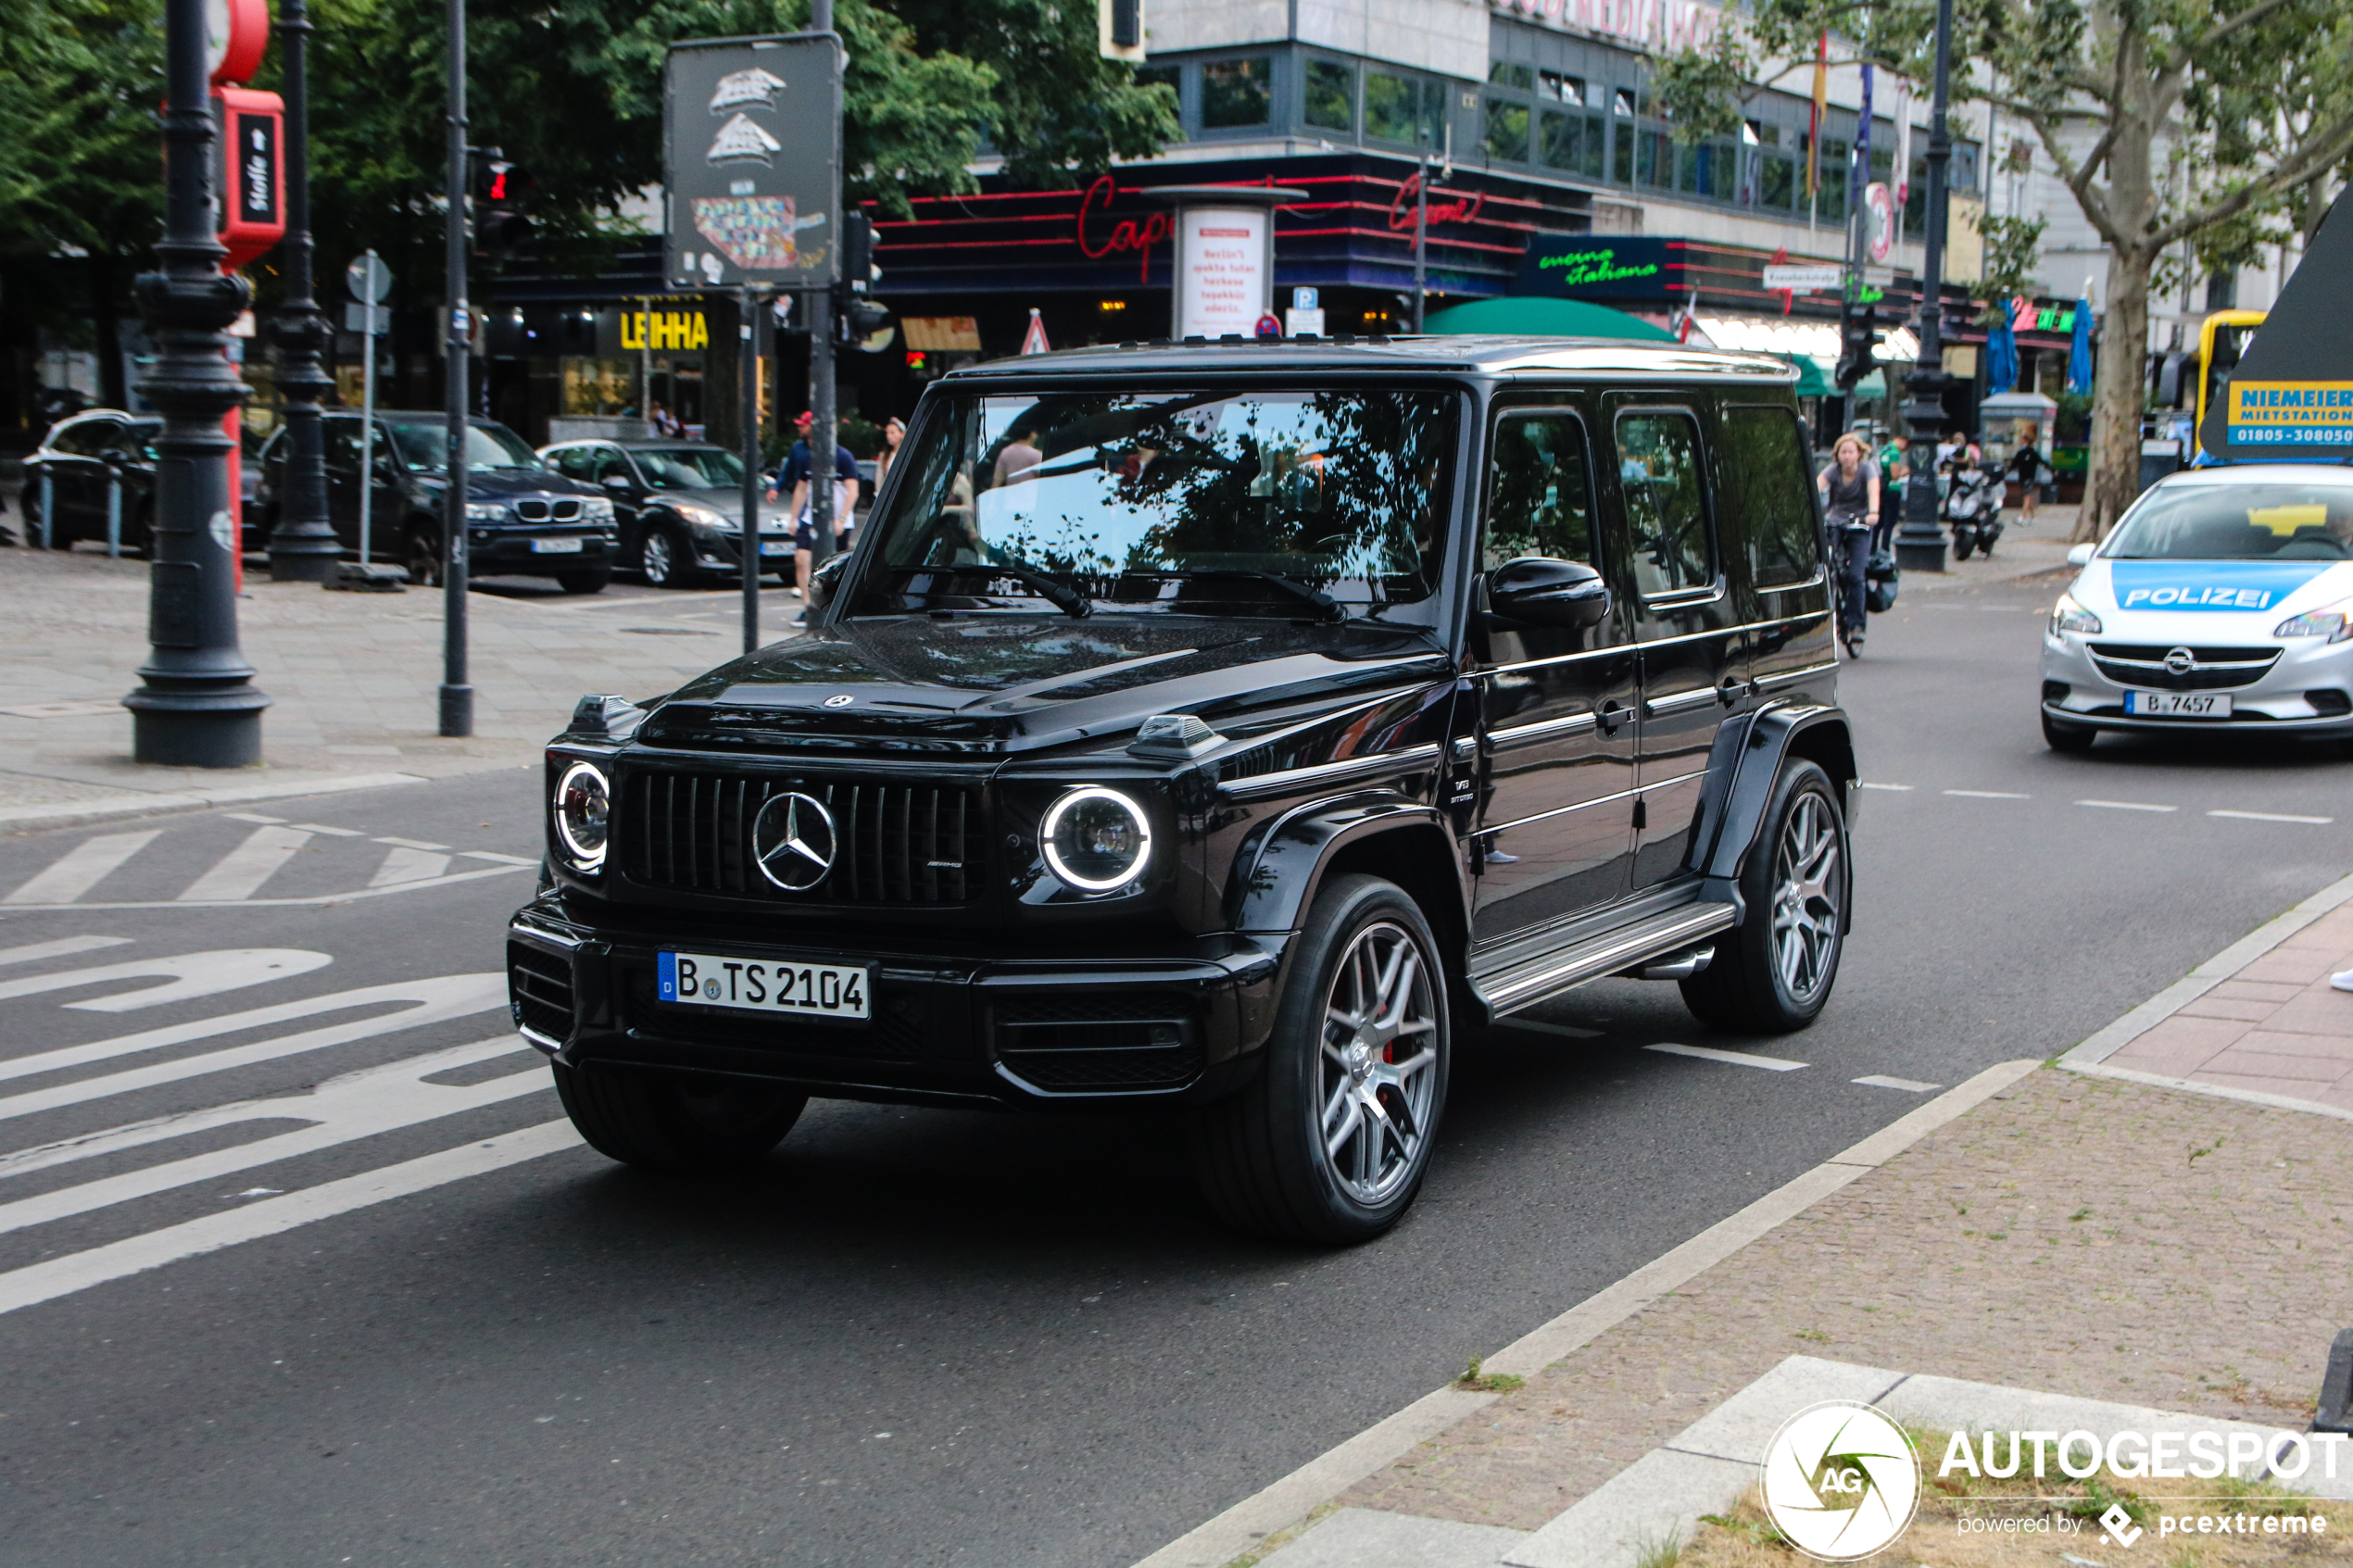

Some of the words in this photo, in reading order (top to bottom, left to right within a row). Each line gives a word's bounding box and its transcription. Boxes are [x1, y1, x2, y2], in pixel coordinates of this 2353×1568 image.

[246, 155, 269, 211] Stoffe
[1539, 248, 1614, 269] cucina
[1566, 259, 1658, 285] italiana
[2241, 390, 2353, 407] NIEMEIER
[2240, 410, 2353, 420] MIETSTATION
[2124, 586, 2271, 609] POLIZEI
[2148, 696, 2159, 711] B
[2171, 696, 2215, 713] 7457
[678, 958, 698, 997] B
[723, 961, 766, 1003] TS
[776, 966, 862, 1011] 2104
